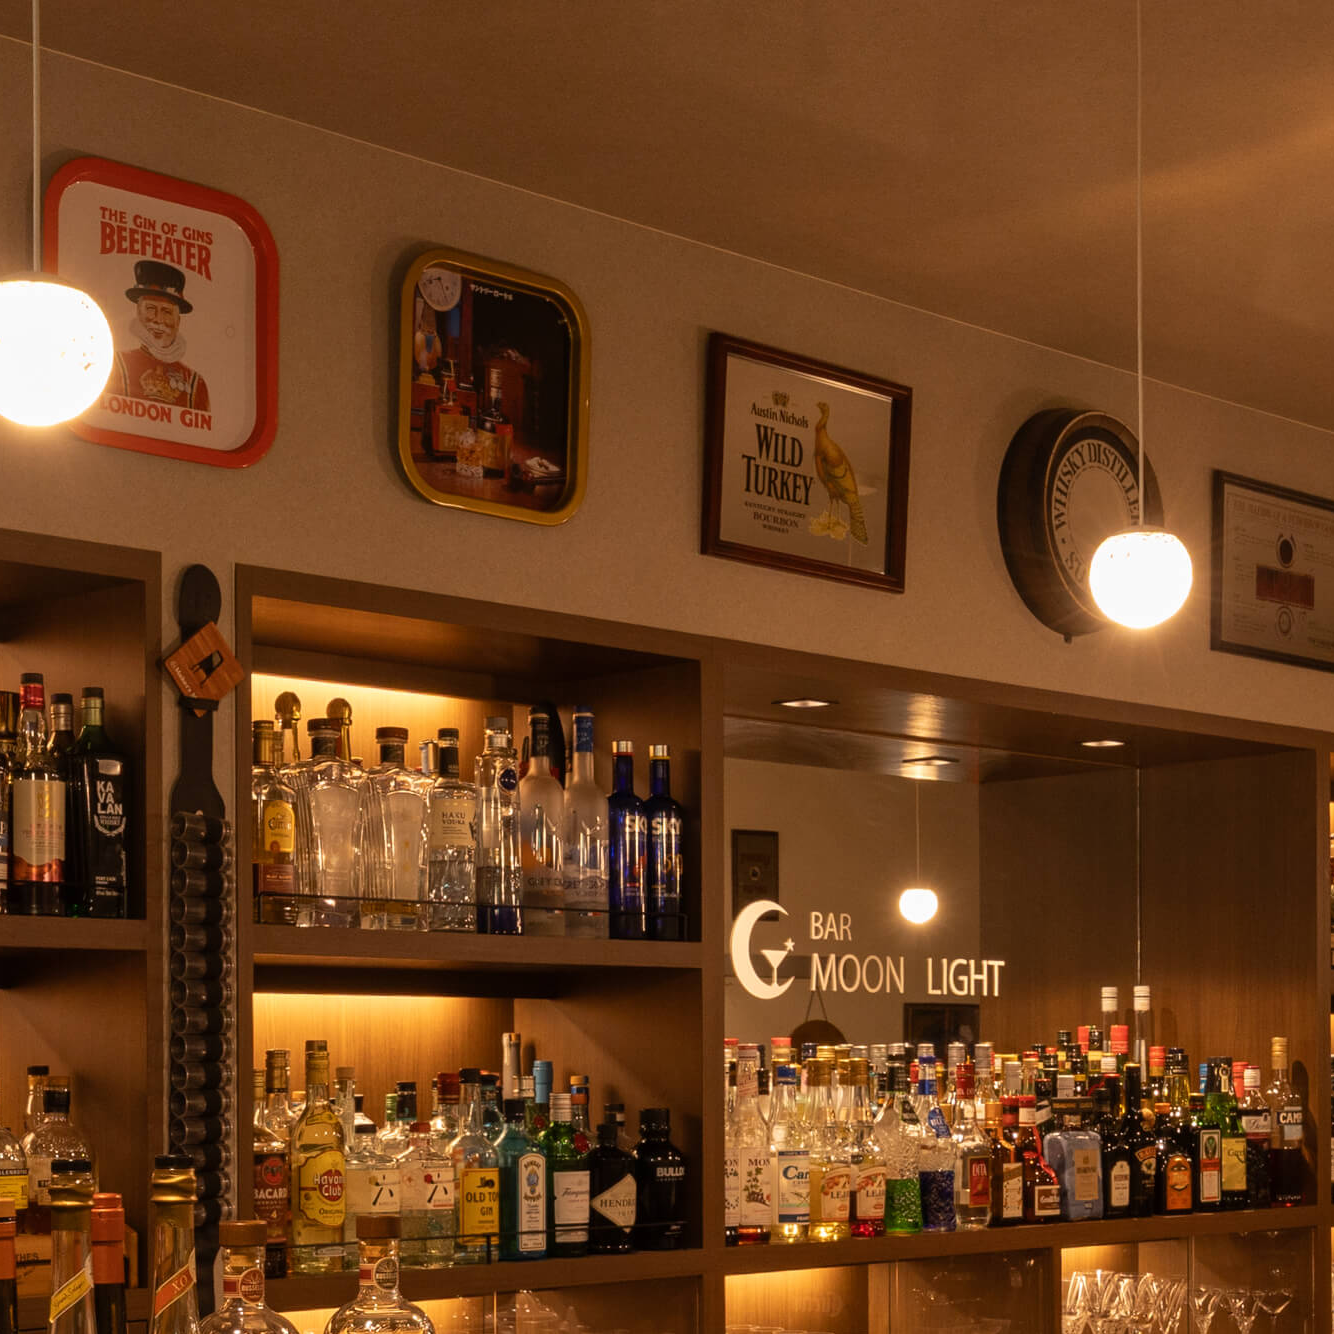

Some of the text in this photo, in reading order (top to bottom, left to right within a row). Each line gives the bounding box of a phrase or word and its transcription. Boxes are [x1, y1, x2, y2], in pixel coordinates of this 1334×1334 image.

[100, 206, 213, 246] THE GIN OF GINS
[100, 220, 213, 281] BEEFEATER
[100, 394, 213, 432] LONDON GIN
[751, 401, 810, 430] Austin Nichols
[754, 423, 804, 468] WILD
[741, 454, 814, 506] TURKEY
[1053, 444, 1087, 531] WHISKY
[753, 511, 799, 529] BOURBON
[96, 780, 115, 793] KA
[97, 791, 115, 804] VA
[96, 802, 124, 815] LAN
[810, 911, 852, 942] BAR
[810, 952, 1005, 997] MOON LIGHT
[322, 1182, 342, 1197] Club
[466, 1193, 486, 1203] OLD
[480, 1206, 493, 1216] GIN
